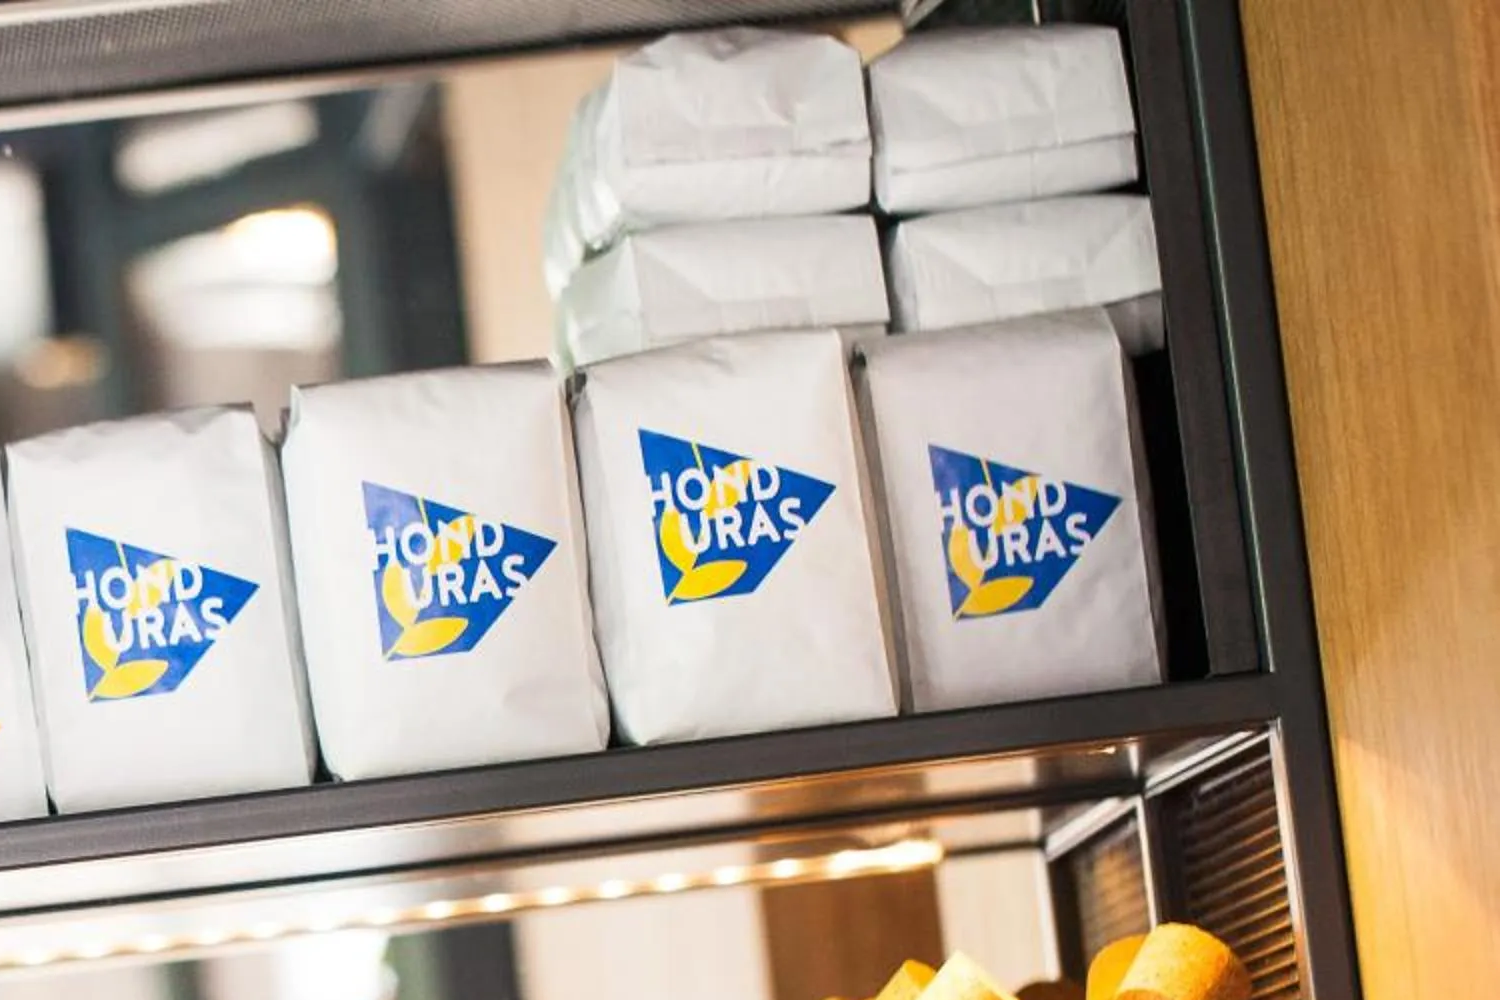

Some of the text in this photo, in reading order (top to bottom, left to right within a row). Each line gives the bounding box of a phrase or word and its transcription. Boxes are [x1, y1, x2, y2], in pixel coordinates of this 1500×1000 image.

[648, 464, 781, 518] HOND
[935, 480, 1067, 533] HOND
[368, 518, 505, 571] HOND
[680, 496, 805, 554] URAS
[968, 511, 1093, 572] URAS
[69, 562, 204, 616] HOND
[403, 553, 529, 610] URAS
[102, 596, 227, 652] URAS
